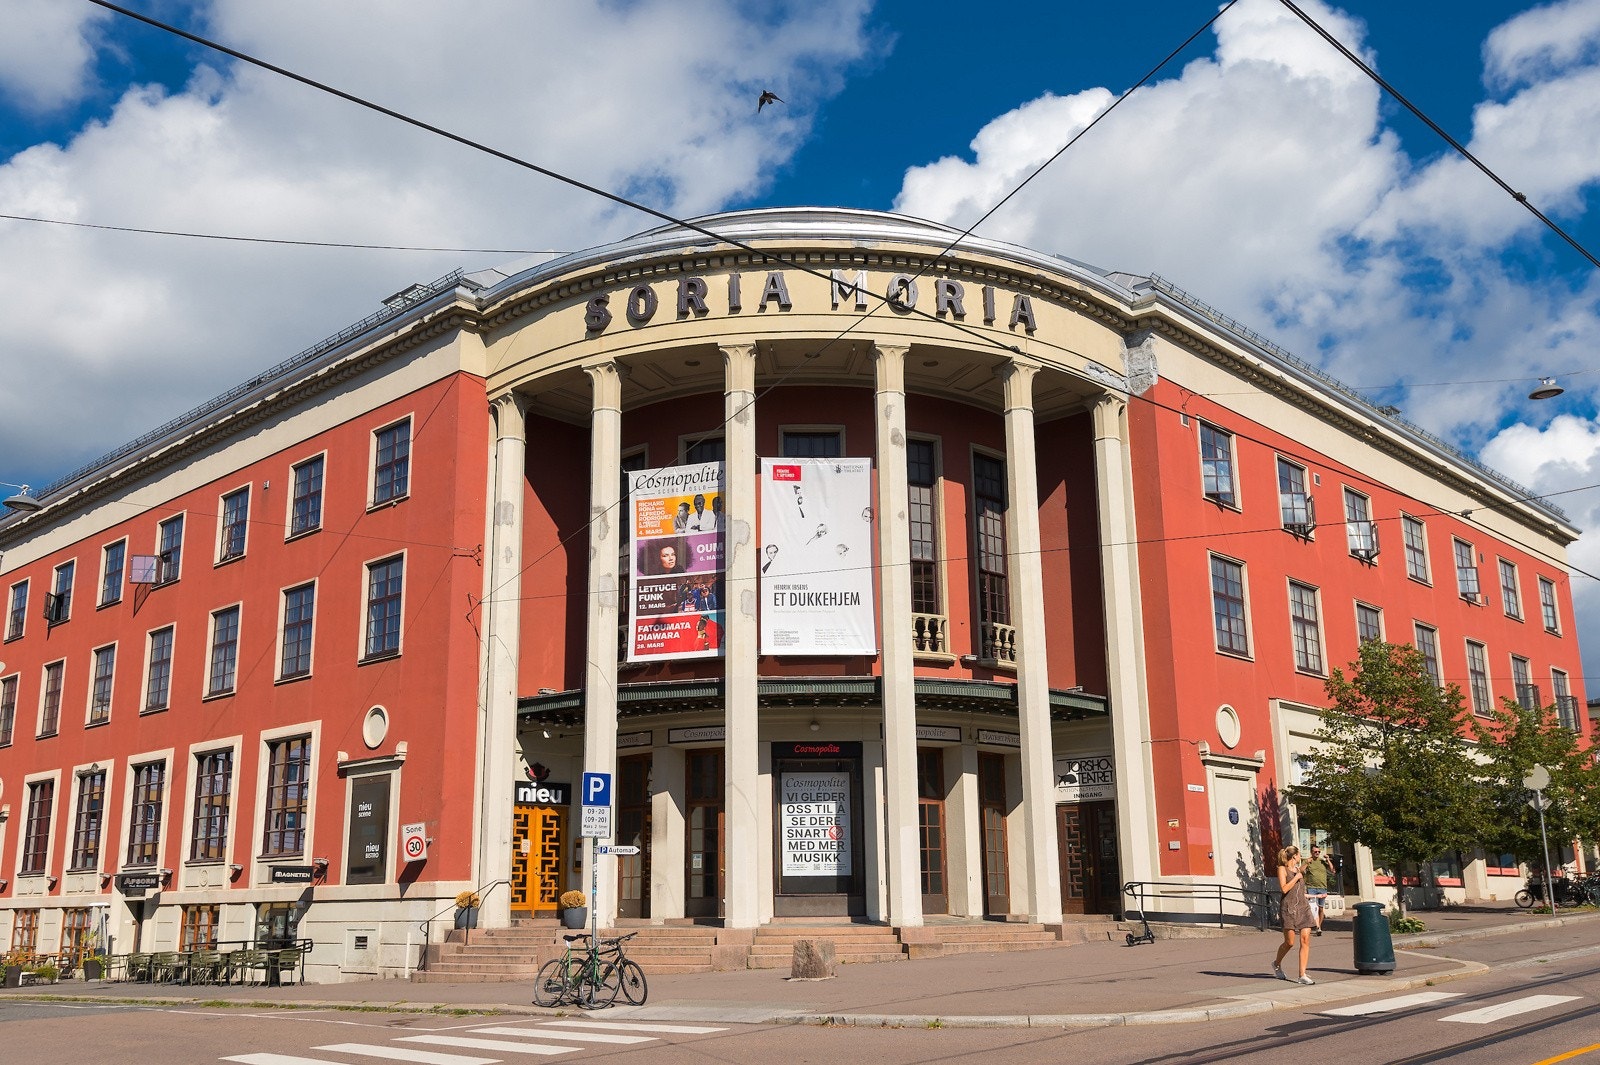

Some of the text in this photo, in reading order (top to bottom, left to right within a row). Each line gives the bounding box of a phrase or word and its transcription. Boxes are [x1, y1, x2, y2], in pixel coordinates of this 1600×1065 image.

[586, 268, 1037, 337] SORIA MORIA
[636, 466, 723, 492] Cosmopolite
[696, 543, 723, 553] OUM
[638, 584, 676, 593] LETTUCE
[639, 593, 663, 601] FUNK
[774, 592, 860, 606] ET DUKKEHJEM
[638, 622, 691, 632] FATOUMATA
[637, 632, 680, 641] DIAWARA
[794, 745, 840, 756] Cosmopolite
[1076, 770, 1113, 784] TEATRET
[786, 777, 846, 790] Cosmopolite
[518, 782, 562, 803] nieu
[590, 777, 604, 801] P
[787, 793, 845, 801] VI GLEDER
[358, 802, 372, 811] nieu
[787, 805, 812, 813] OSS
[815, 805, 833, 813] TIL
[791, 817, 840, 826] SE DERE
[787, 829, 828, 838] SNART
[366, 842, 380, 852] nieu
[410, 842, 420, 852] 30
[788, 841, 845, 850] MED MER
[793, 853, 841, 862] MUSIKK
